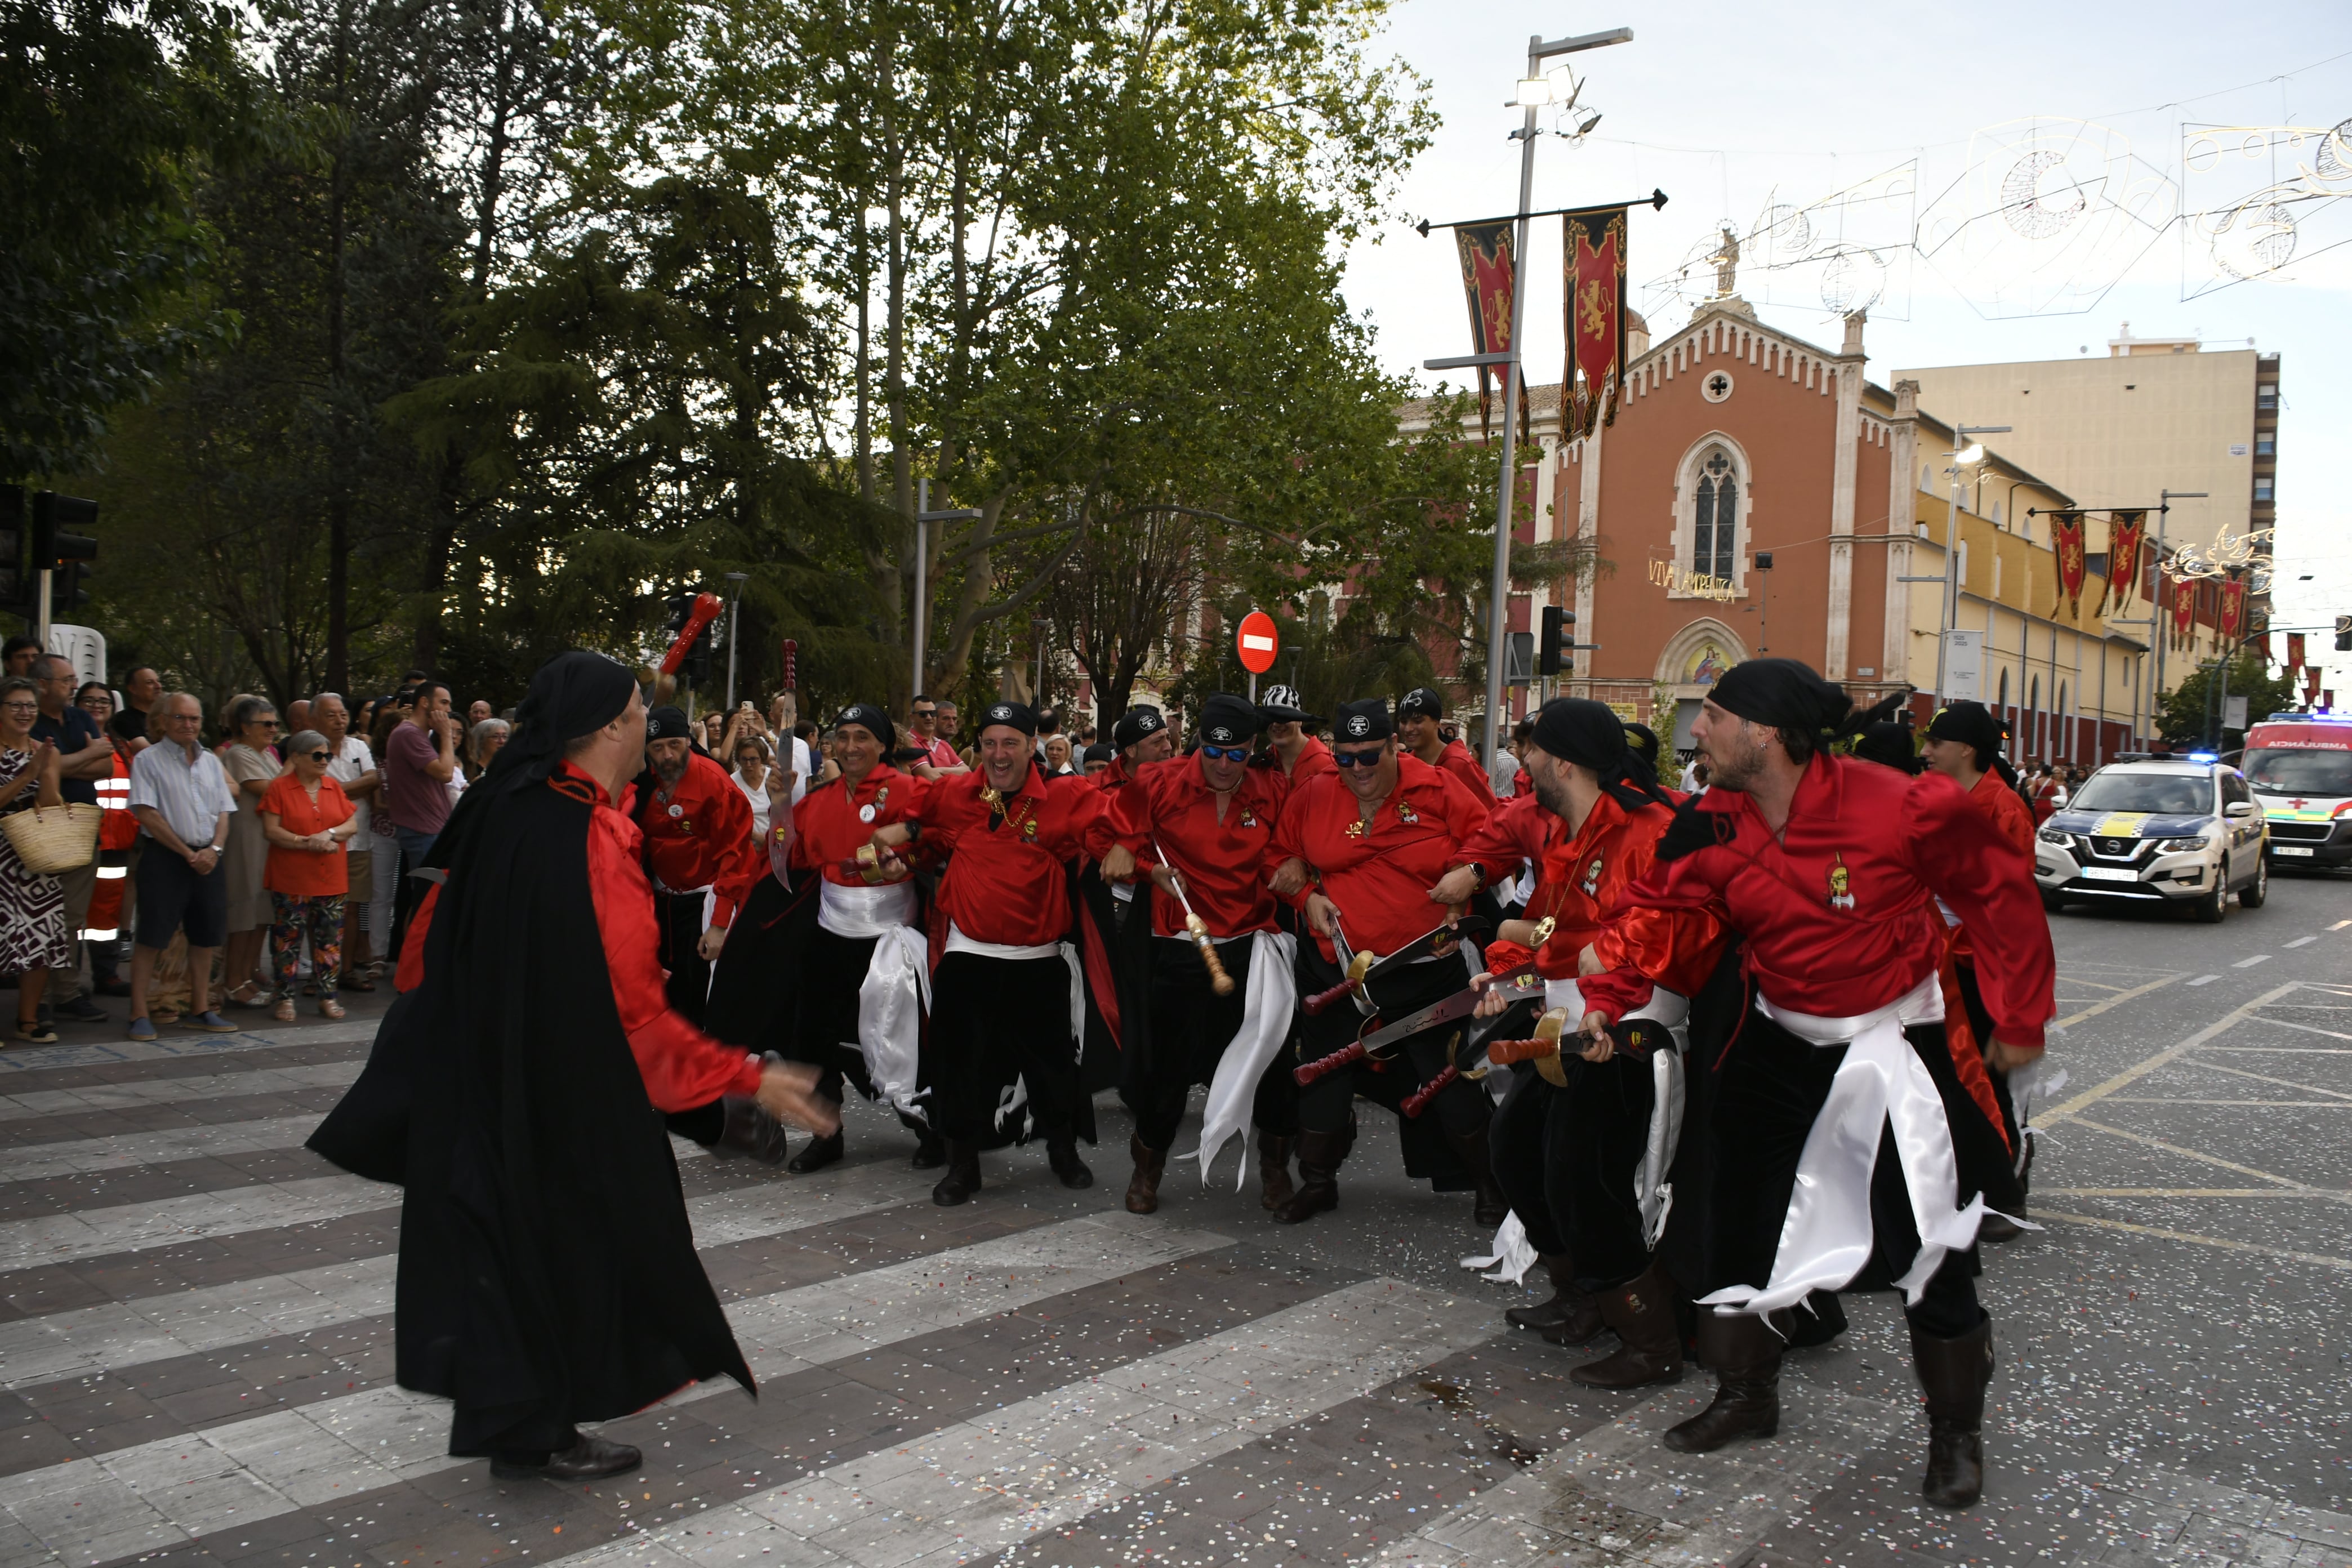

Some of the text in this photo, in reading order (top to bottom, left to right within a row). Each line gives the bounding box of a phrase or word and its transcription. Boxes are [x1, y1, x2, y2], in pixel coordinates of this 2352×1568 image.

[1649, 558, 1674, 589] VIVA
[2088, 869, 2135, 880] 9651 LHF
